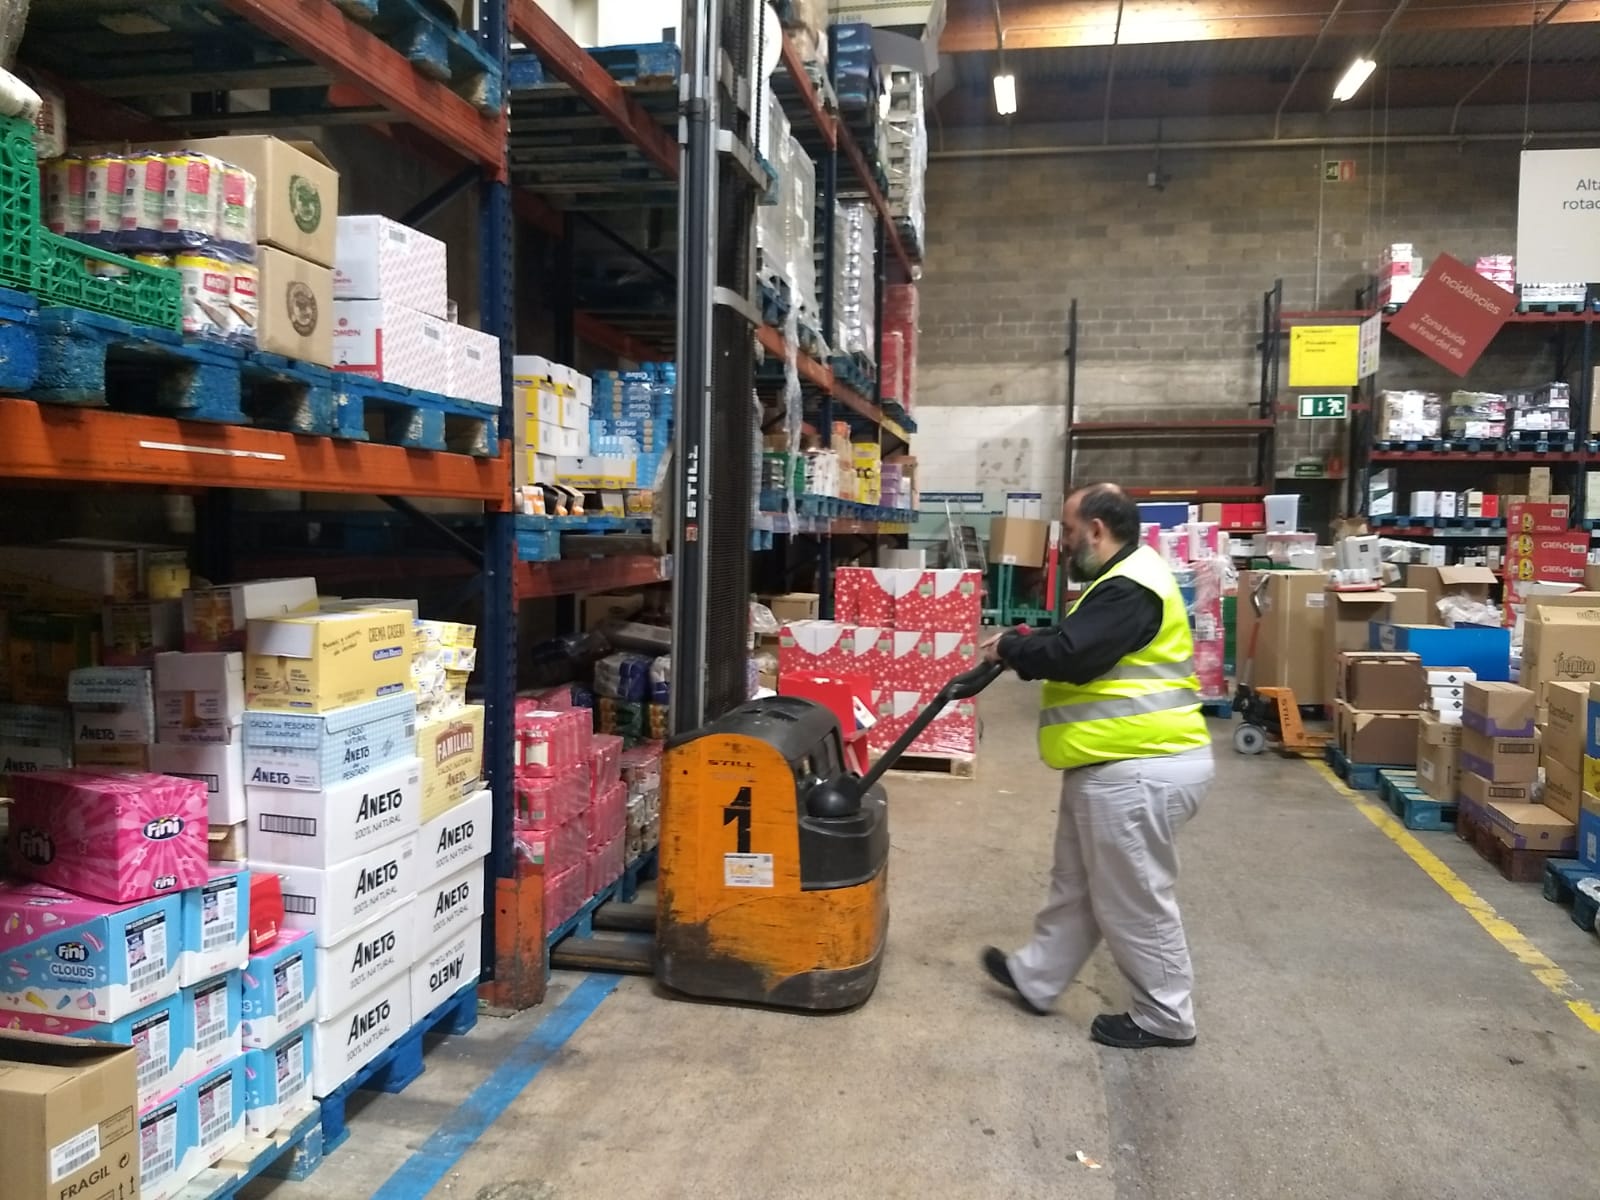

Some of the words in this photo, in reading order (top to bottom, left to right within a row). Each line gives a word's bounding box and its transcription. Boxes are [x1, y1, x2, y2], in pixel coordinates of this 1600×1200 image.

[1576, 178, 1600, 191] Alt
[1440, 272, 1501, 315] Incidències
[686, 445, 698, 518] STILL
[283, 721, 316, 730] PESCADO
[344, 746, 370, 764] ANETO
[437, 732, 473, 762] FAMILIAR
[251, 767, 291, 785] ANETO
[356, 788, 403, 823] ANETO
[723, 786, 752, 853] 1
[146, 815, 182, 839] Fini
[437, 820, 474, 854] ANETO
[155, 875, 175, 889] Fini
[354, 860, 398, 899] ANETO
[434, 881, 469, 918] ANETO
[58, 943, 86, 961] Fini
[351, 930, 395, 973] ANETO
[51, 963, 95, 978] CLOUDS
[429, 953, 464, 992] ANETO
[347, 1000, 390, 1045] ANETO
[60, 1165, 110, 1200] FRAGIL
